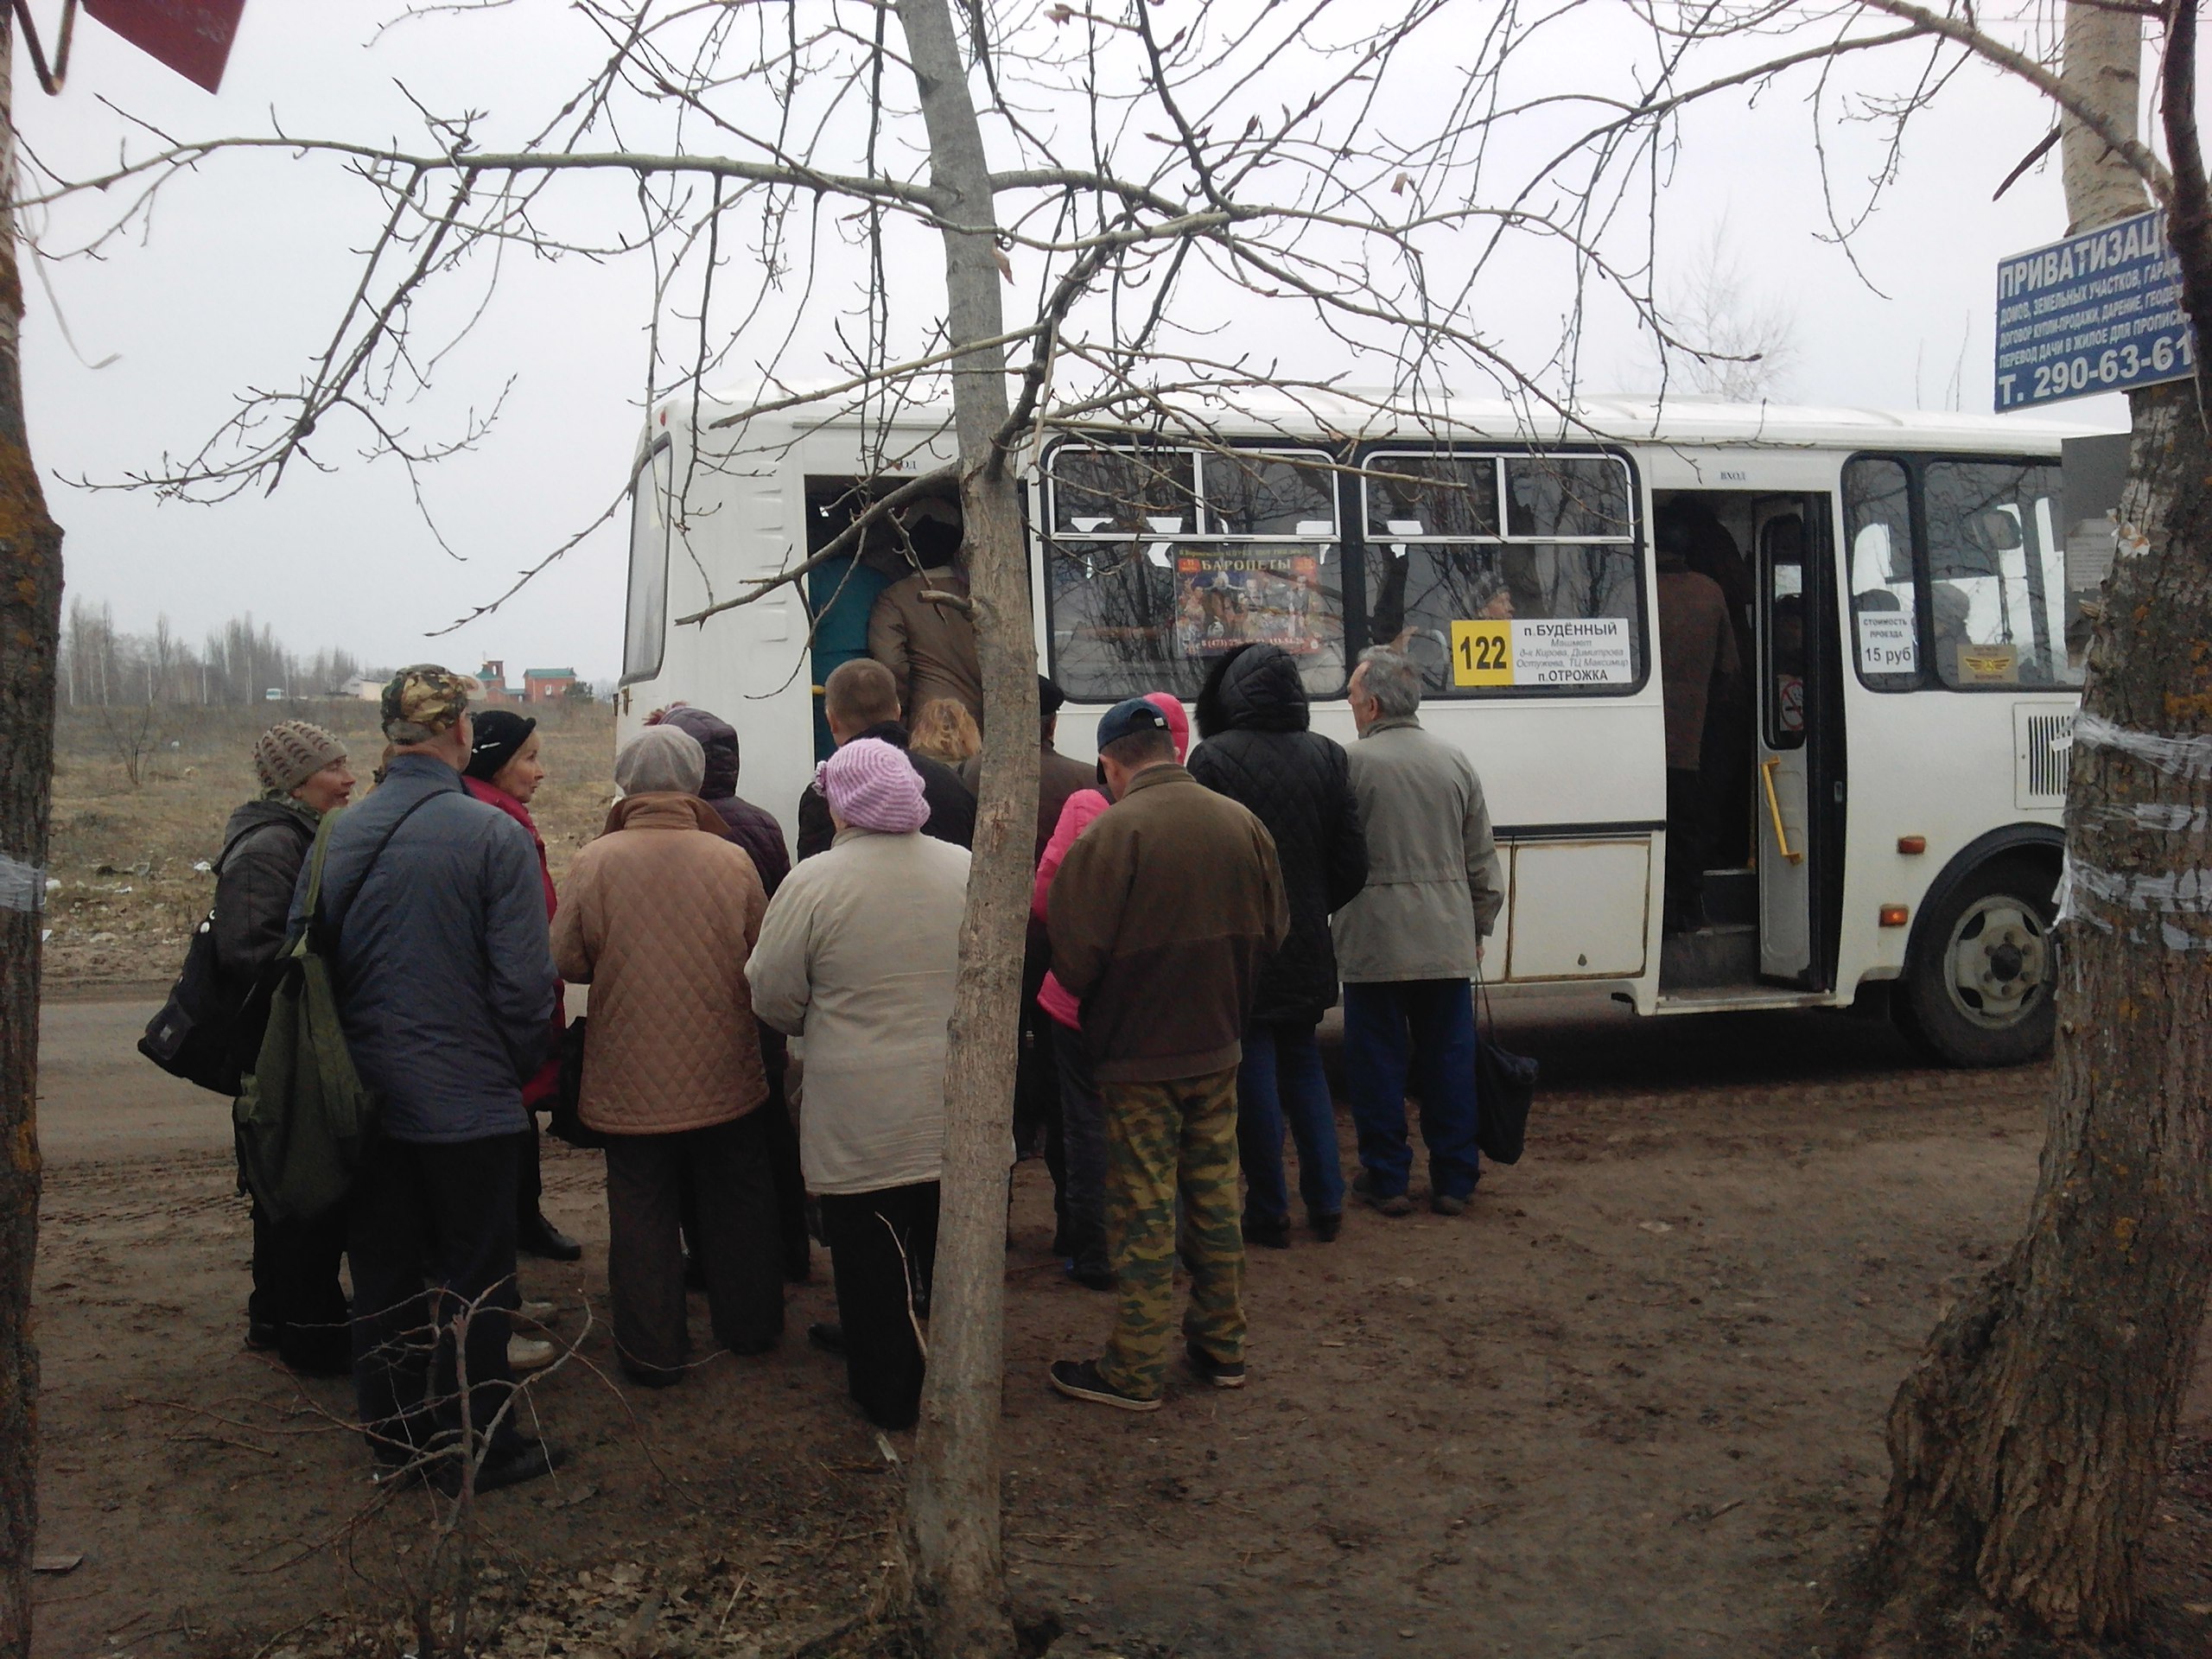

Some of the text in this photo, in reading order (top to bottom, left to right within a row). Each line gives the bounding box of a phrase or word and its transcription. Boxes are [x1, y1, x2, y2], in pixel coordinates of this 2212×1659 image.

[2089, 269, 2141, 300] УЧАСТКОВ,
[1999, 346, 2037, 369] ПЕРЕВОД
[2039, 340, 2063, 362] ДАЧИ
[2065, 338, 2072, 353] В
[2074, 328, 2108, 351] ЖИЛОЕ
[2109, 321, 2131, 345] ДЛЯ
[1998, 330, 2192, 405] Т. 290-63-61
[1863, 618, 1907, 626] СТОИМОСТЬ
[1460, 636, 1507, 671] 122
[1568, 658, 1581, 668] ТЦ
[1866, 647, 1911, 665] 15 руб
